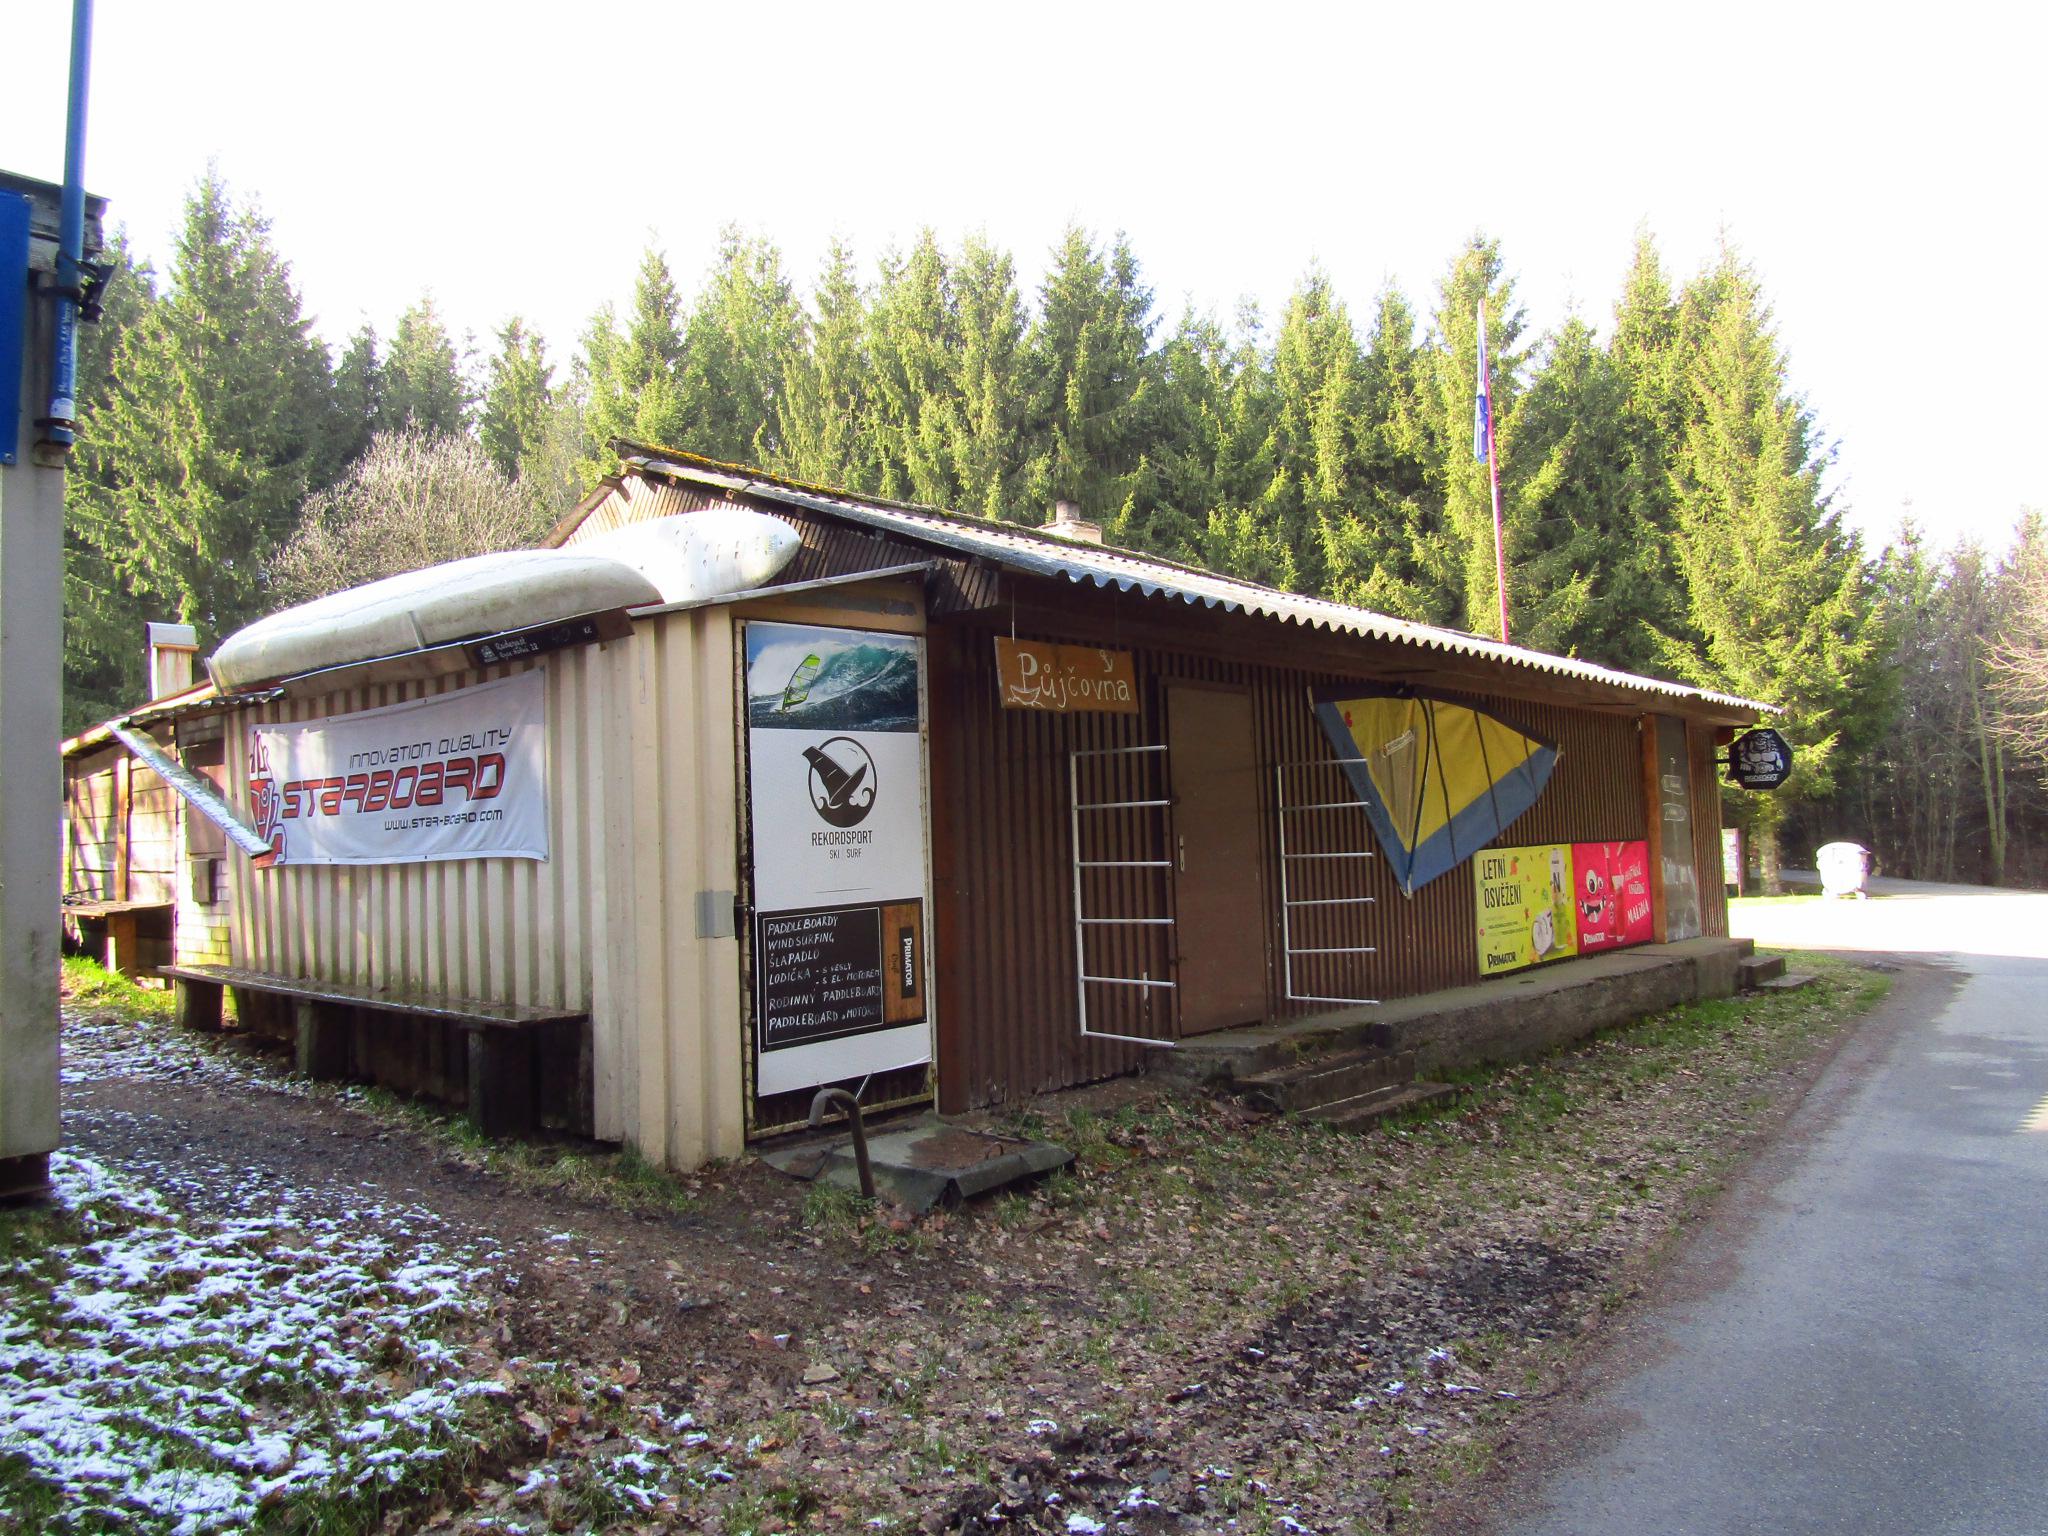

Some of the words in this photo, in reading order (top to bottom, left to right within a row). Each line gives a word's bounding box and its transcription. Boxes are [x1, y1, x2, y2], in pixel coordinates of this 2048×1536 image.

[1014, 652, 1131, 708] Půjčovna
[439, 727, 512, 754] QUALITY
[282, 752, 506, 819] STARBOARD
[811, 830, 873, 846] REKORDSPORT
[829, 849, 840, 859] SKI
[846, 848, 862, 858] SURF
[1482, 855, 1506, 881] LETNÍ
[1484, 880, 1522, 908] OSVĚŽENÍ
[903, 937, 913, 987] PRIMATOR
